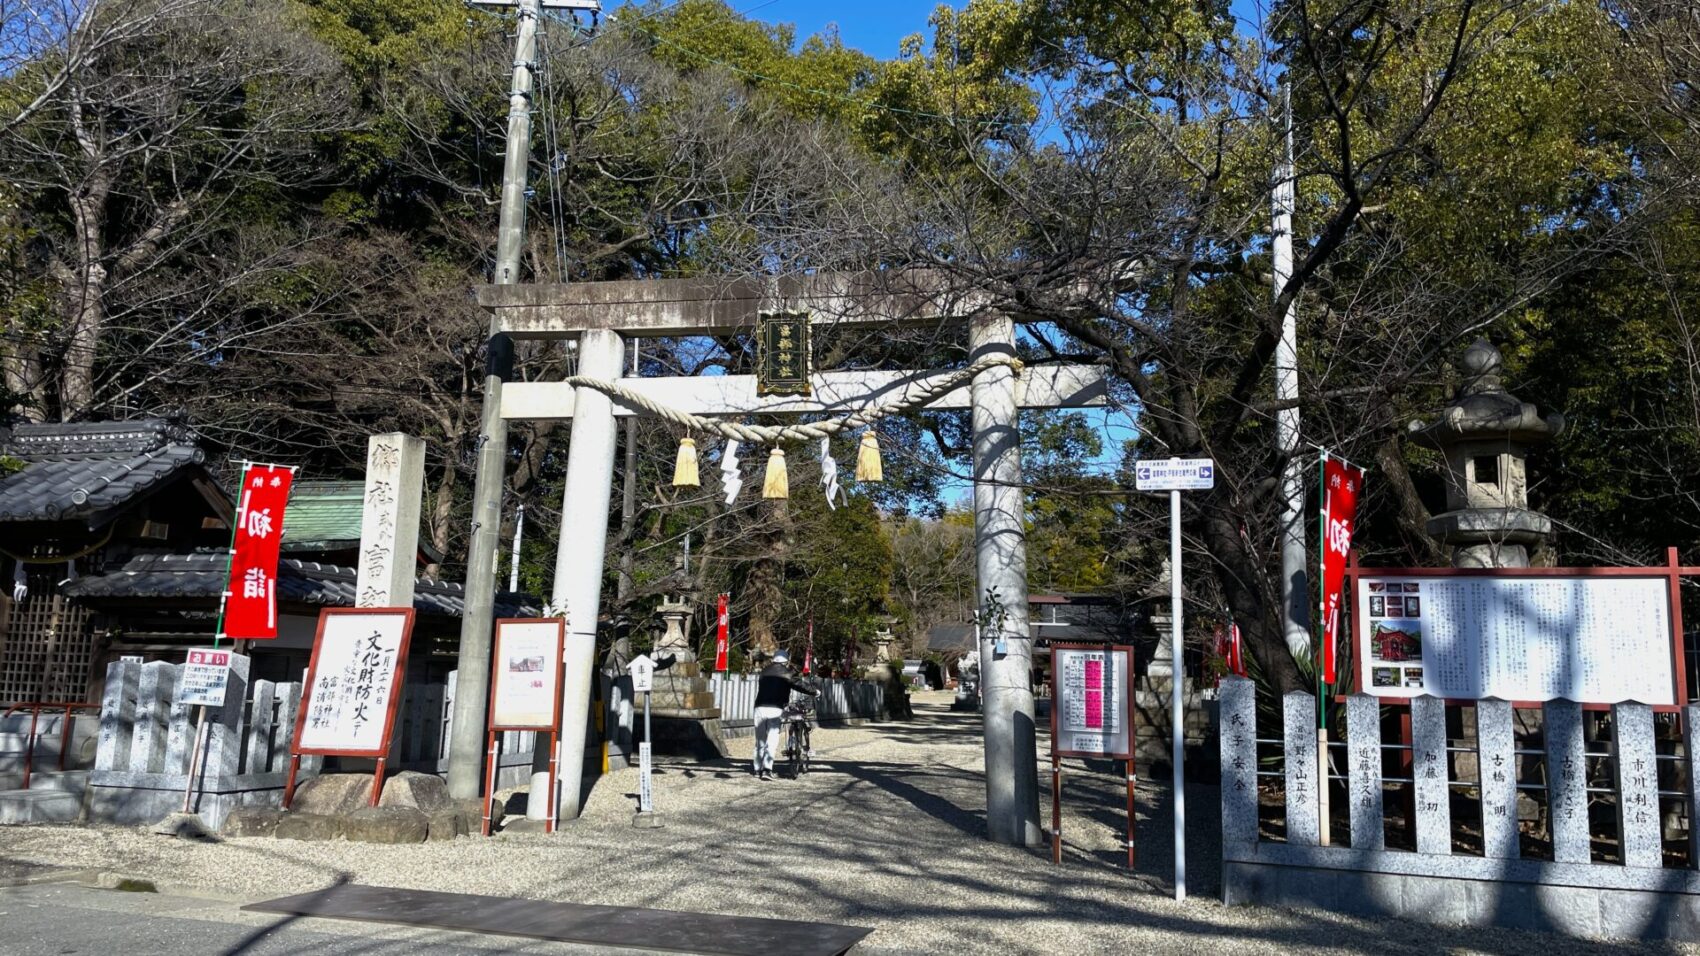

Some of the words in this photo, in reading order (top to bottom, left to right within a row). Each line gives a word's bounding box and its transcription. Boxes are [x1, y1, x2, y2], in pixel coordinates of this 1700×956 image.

[192, 653, 226, 664] お願い
[352, 630, 383, 738] 文化財防火デー
[375, 647, 395, 705] 一月二十六日
[311, 676, 329, 729] 南消防署
[321, 676, 339, 728] 富部神社
[1230, 713, 1246, 791] 氏子安全
[1358, 747, 1373, 808] 近藤喜久雄
[1631, 758, 1648, 824] 市川利信
